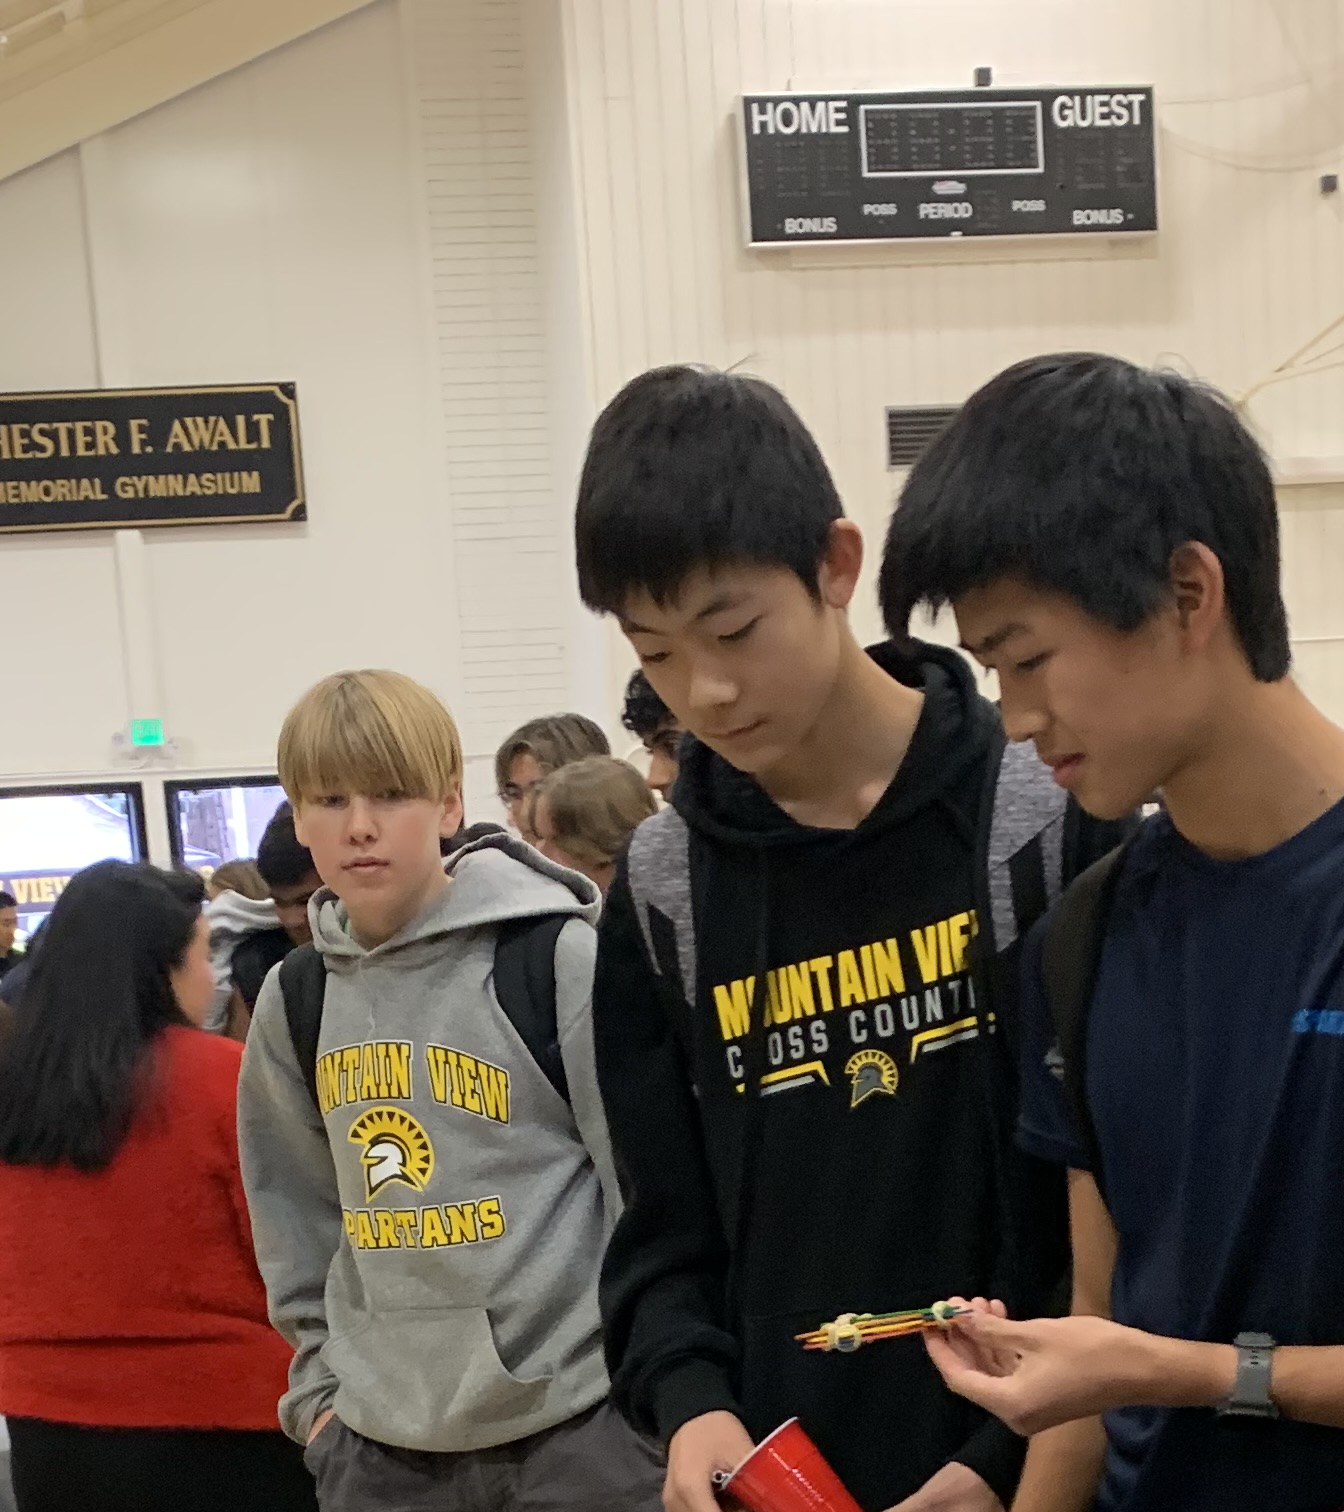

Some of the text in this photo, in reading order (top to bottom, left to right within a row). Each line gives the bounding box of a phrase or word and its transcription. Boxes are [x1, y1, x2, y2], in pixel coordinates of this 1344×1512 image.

[751, 101, 850, 135] HOME
[1052, 93, 1146, 128] GUEST
[862, 202, 898, 217] POSS
[919, 201, 973, 220] PERIOD
[1012, 199, 1046, 213] POSS
[1072, 209, 1124, 226] BONUS
[784, 217, 837, 234] BONUS
[130, 418, 154, 455] F.
[166, 413, 274, 454] AWALT
[114, 471, 262, 500] GYMNASIUM
[712, 937, 907, 1042] MUNTAIN
[725, 1018, 830, 1080] COSS
[425, 1043, 512, 1126] VIEW
[342, 1196, 507, 1251] PARTANS
